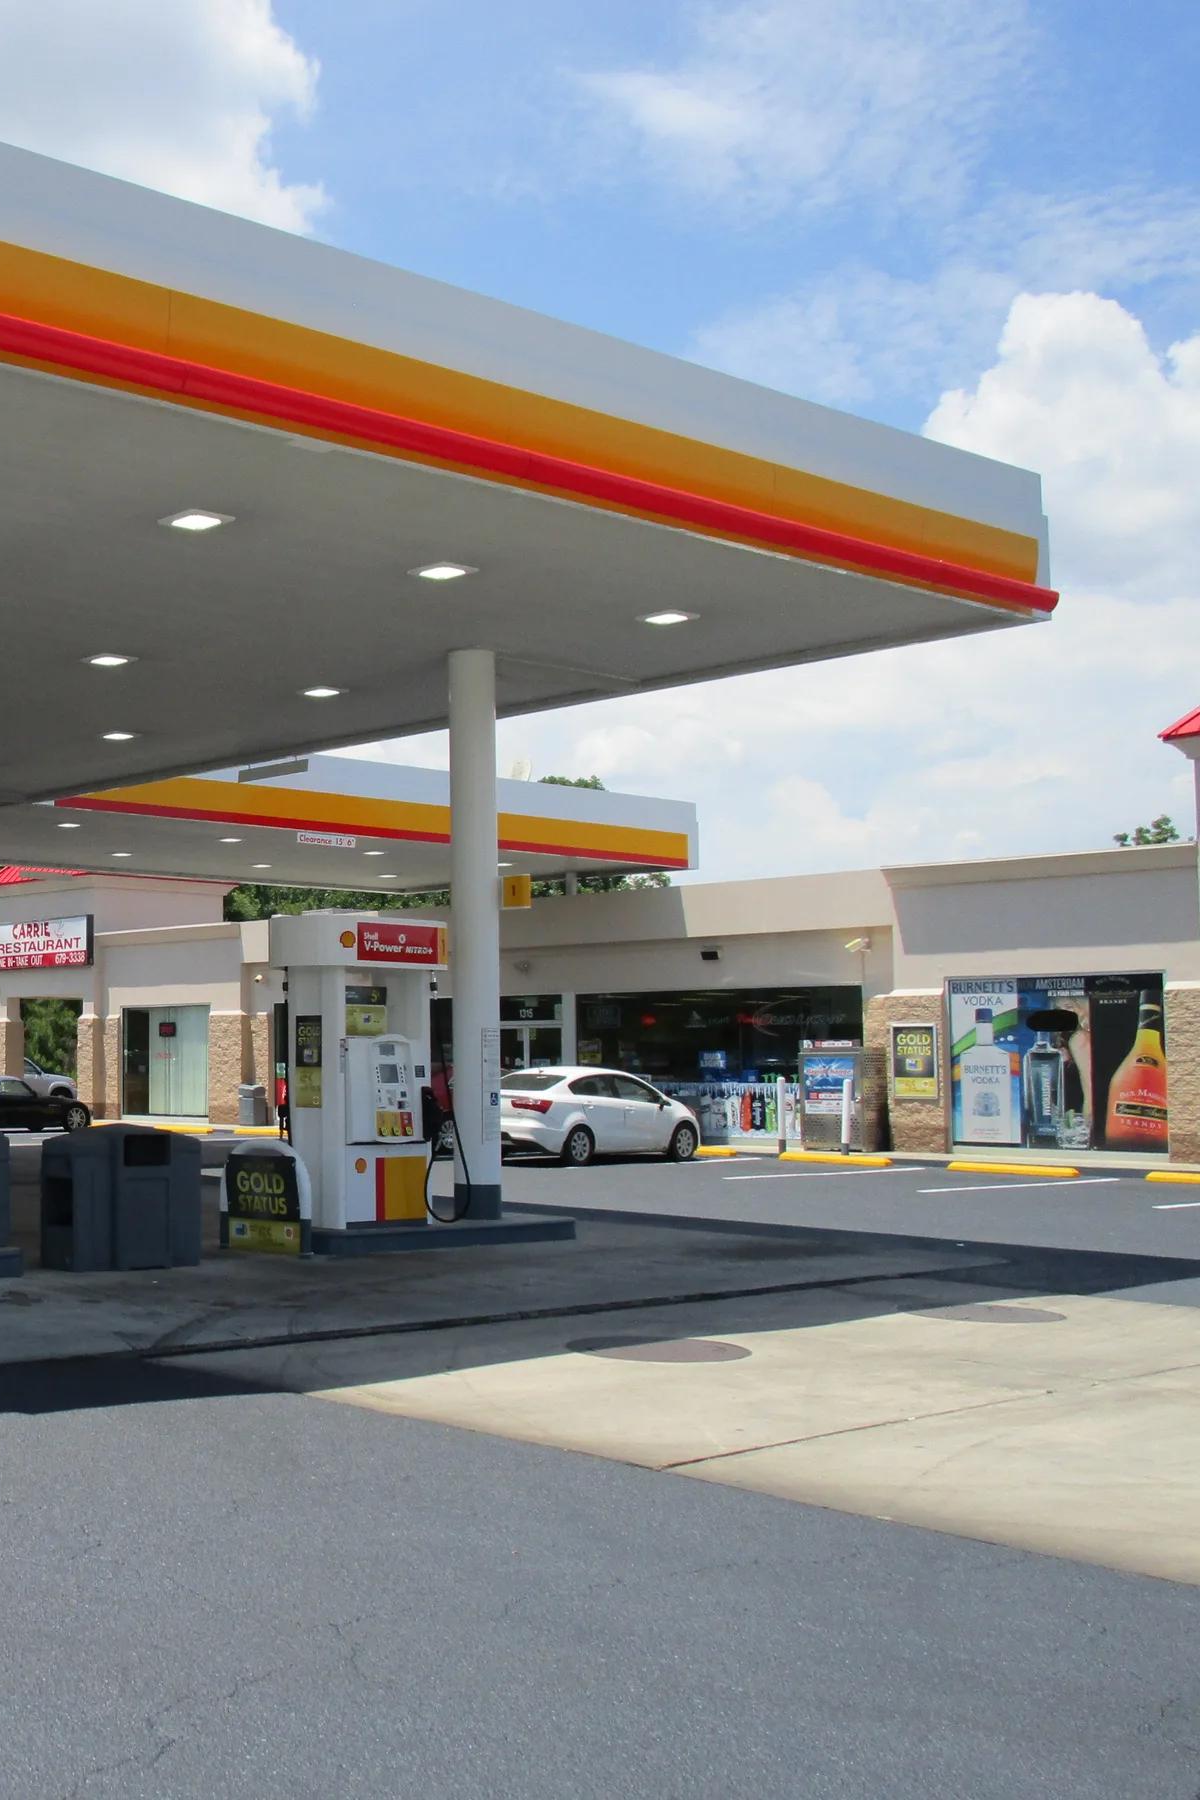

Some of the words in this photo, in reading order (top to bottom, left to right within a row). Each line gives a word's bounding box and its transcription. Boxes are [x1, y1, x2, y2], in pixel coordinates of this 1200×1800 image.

[300, 834, 332, 845] Clearance
[12, 921, 51, 939] CARRIE
[363, 931, 379, 941] Shell
[364, 940, 402, 953] V-Power
[30, 954, 43, 965] OUT
[952, 980, 1014, 993] BURNETT'S
[1035, 977, 1085, 990] AMSTERDAM
[963, 995, 1004, 1007] VODKA
[896, 1033, 932, 1046] GOLD
[896, 1045, 932, 1056] STATUS
[964, 1065, 1008, 1075] BURNETT'S
[970, 1076, 1001, 1085] VODKA
[236, 1170, 285, 1194] GOLD
[238, 1195, 288, 1215] STATUS
